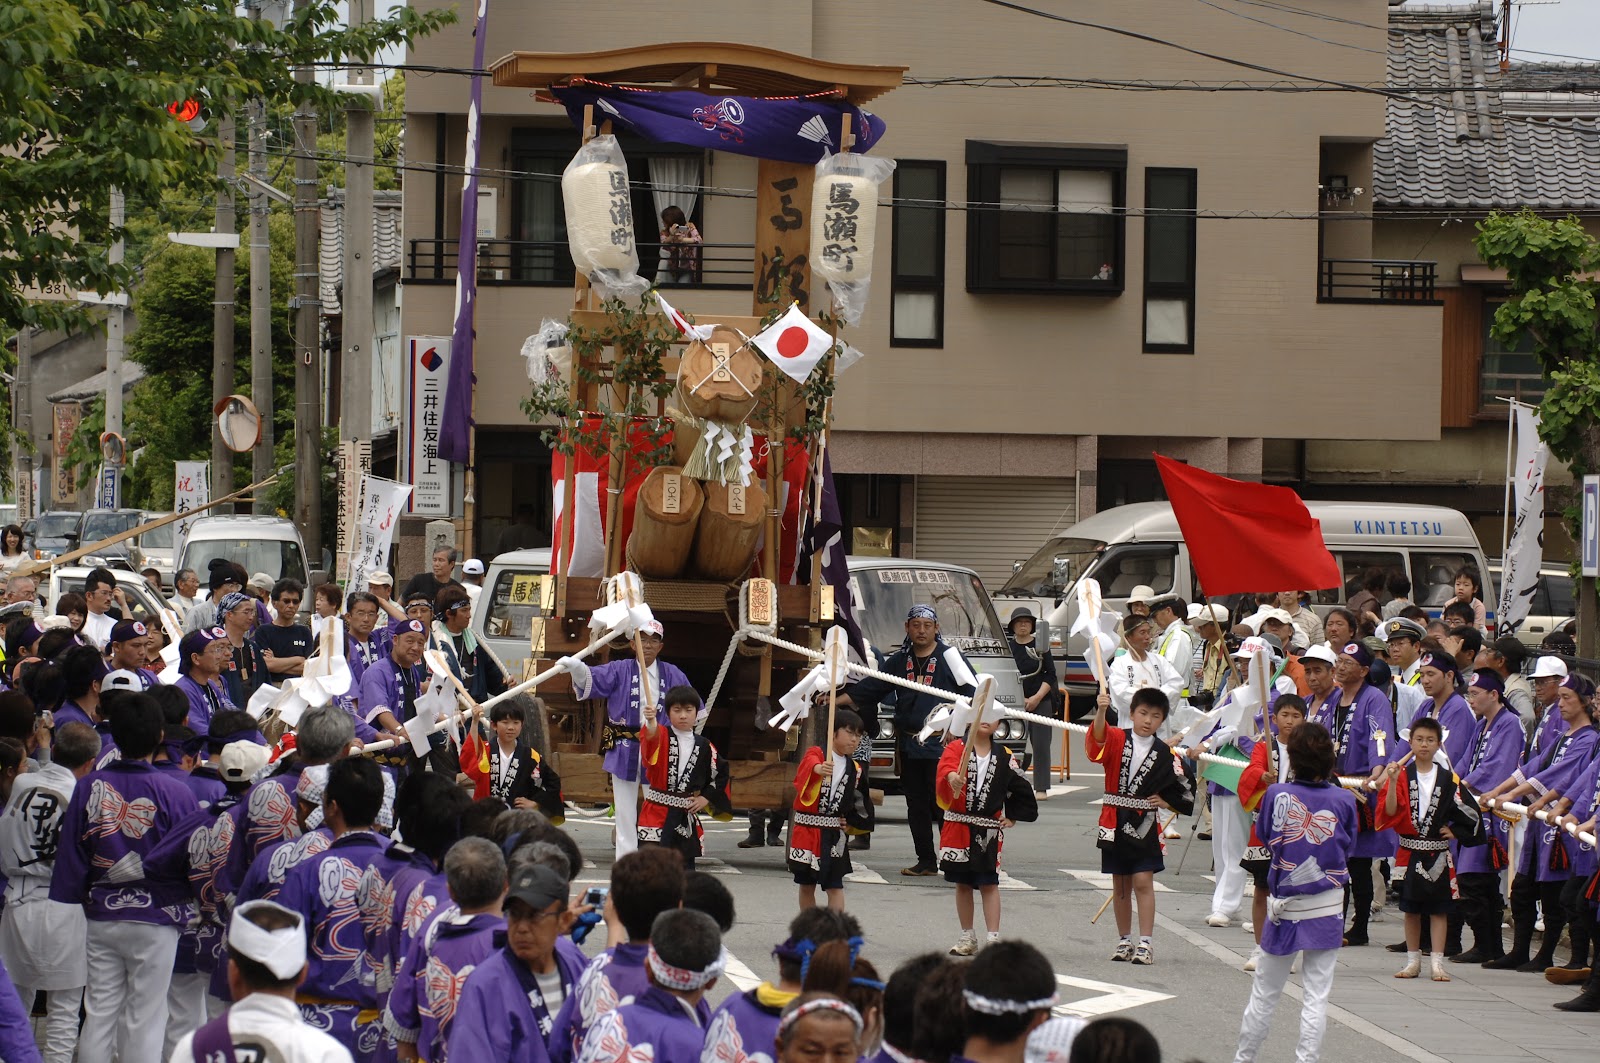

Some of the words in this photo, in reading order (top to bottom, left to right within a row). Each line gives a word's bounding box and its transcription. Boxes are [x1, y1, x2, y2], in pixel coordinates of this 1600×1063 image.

[608, 170, 634, 257] 馬瀬町
[822, 182, 860, 273] 馬瀬町
[423, 378, 438, 475] 三井住友海上
[360, 443, 371, 474] 三和
[1354, 520, 1442, 537] KINTETSU
[881, 571, 911, 584] 馬瀬町
[631, 674, 640, 709] 馬瀬町
[490, 753, 500, 798] 馬瀬町木
[678, 745, 700, 793] 馬瀬町木遣
[977, 754, 998, 812] 馬瀬町木遣子
[1127, 750, 1158, 797] 馬瀬町木遣
[827, 773, 850, 815] 馬瀬町木
[1420, 786, 1442, 838] 馬瀬町木遣
